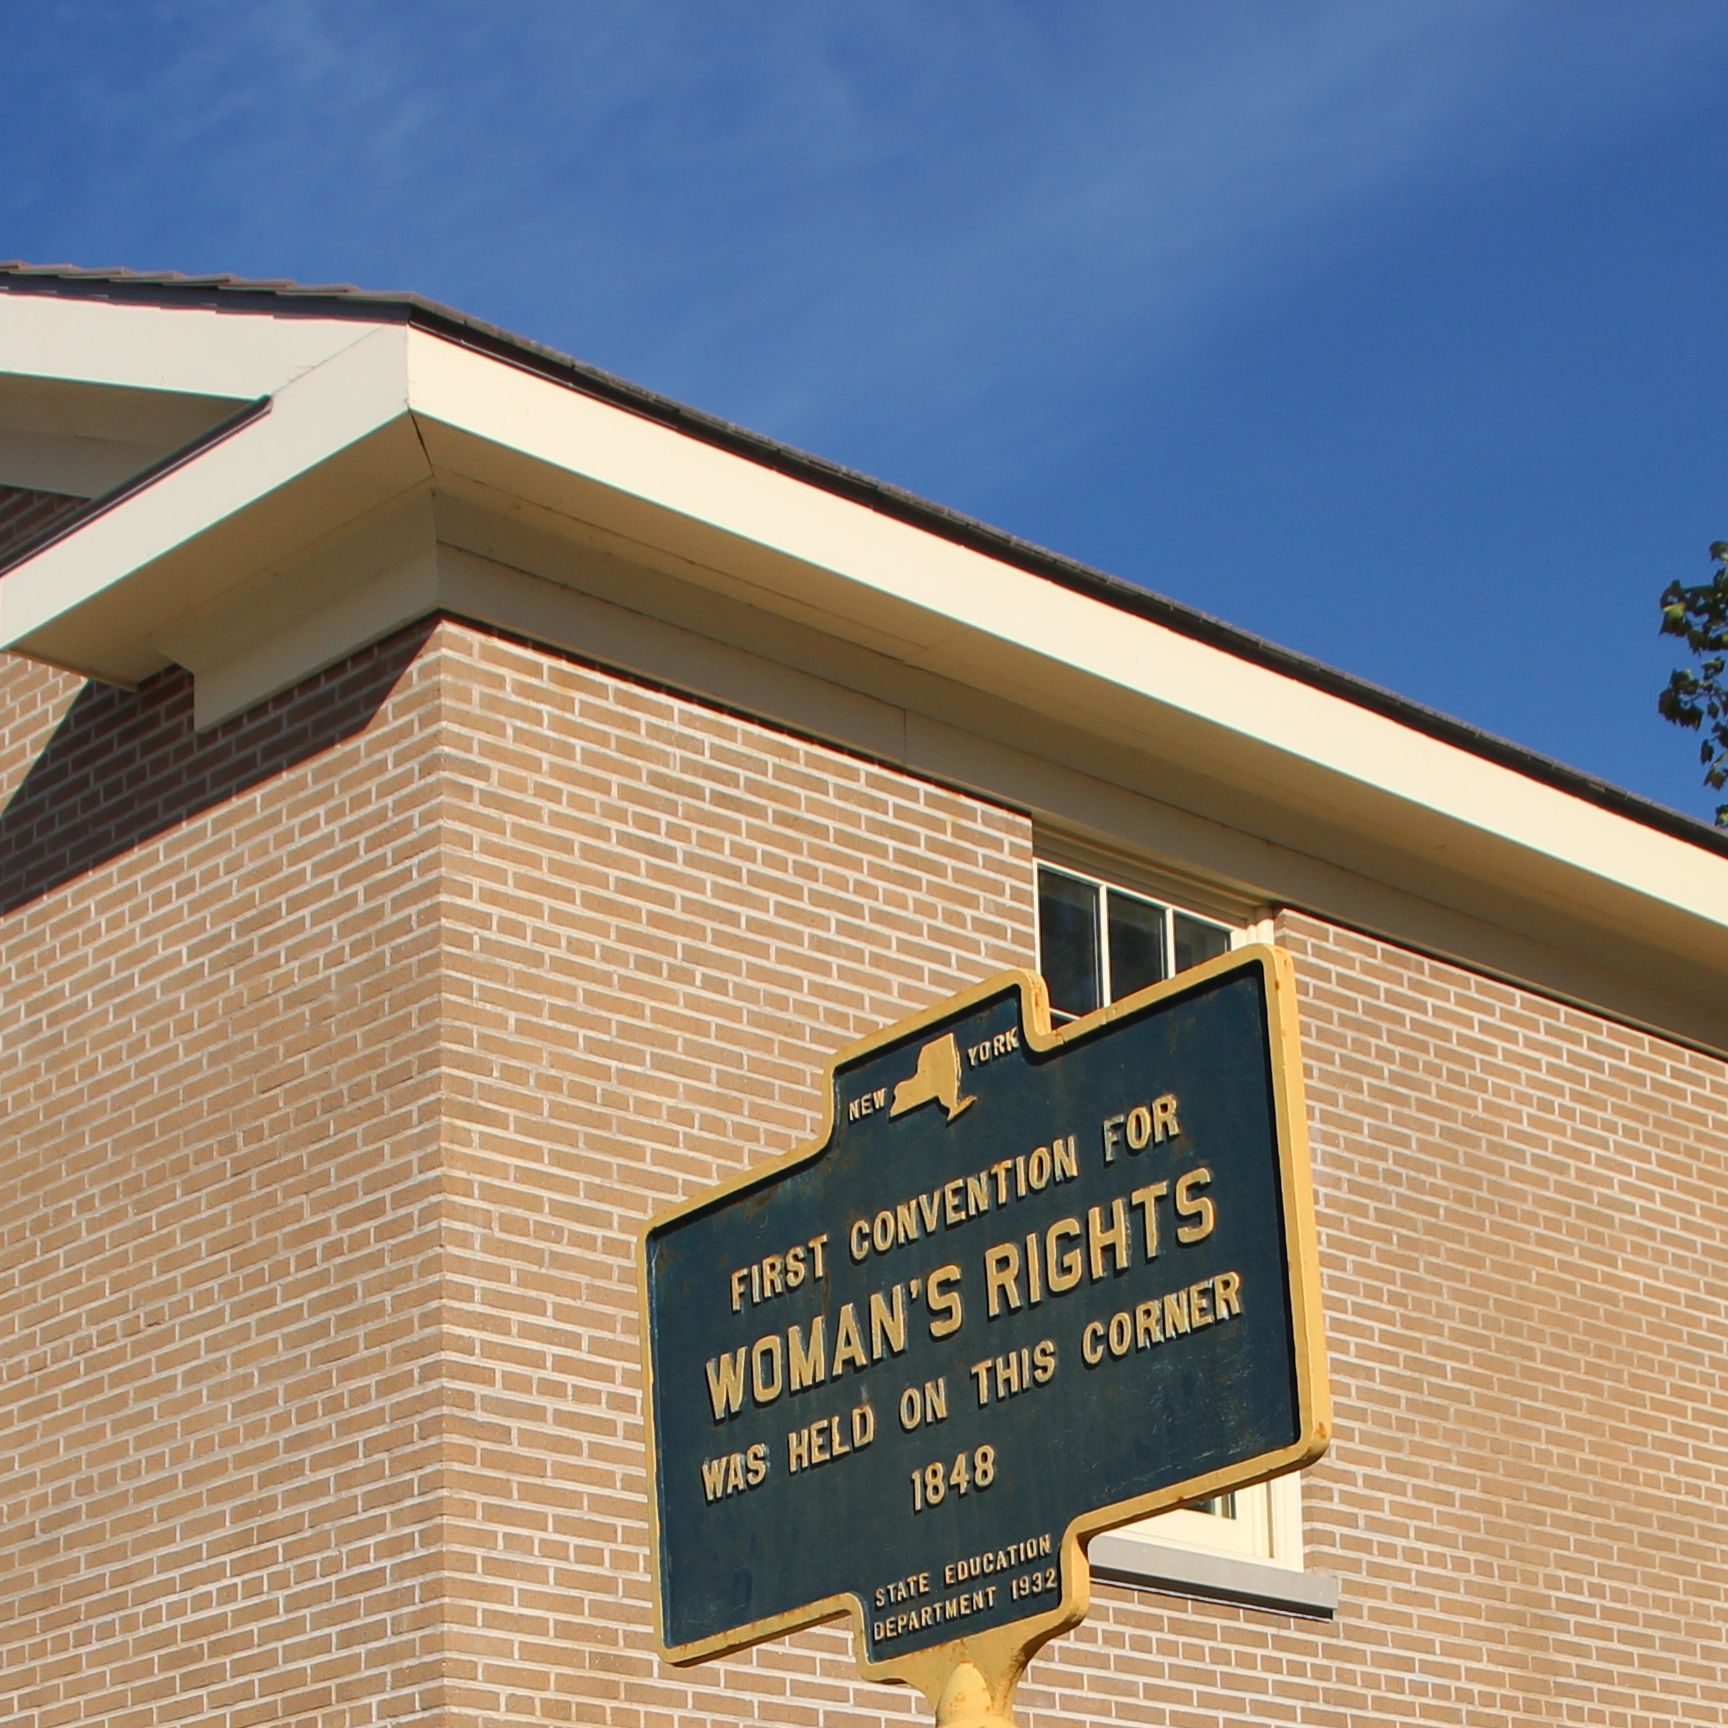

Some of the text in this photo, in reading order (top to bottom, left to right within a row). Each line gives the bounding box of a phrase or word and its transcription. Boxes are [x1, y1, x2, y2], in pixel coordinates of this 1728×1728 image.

[848, 1026, 1020, 1121] NEW YORK
[730, 1093, 1181, 1312] FIRST CONVENTION FOR
[705, 1167, 1216, 1420] WOMAN'S RIGHTS
[702, 1271, 1242, 1501] WAS HELD ON THIS CORNER
[912, 1444, 995, 1511] 1848
[874, 1568, 1057, 1641] DEPARTMENT 1932
[875, 1534, 1051, 1607] STATE EDUCATION
